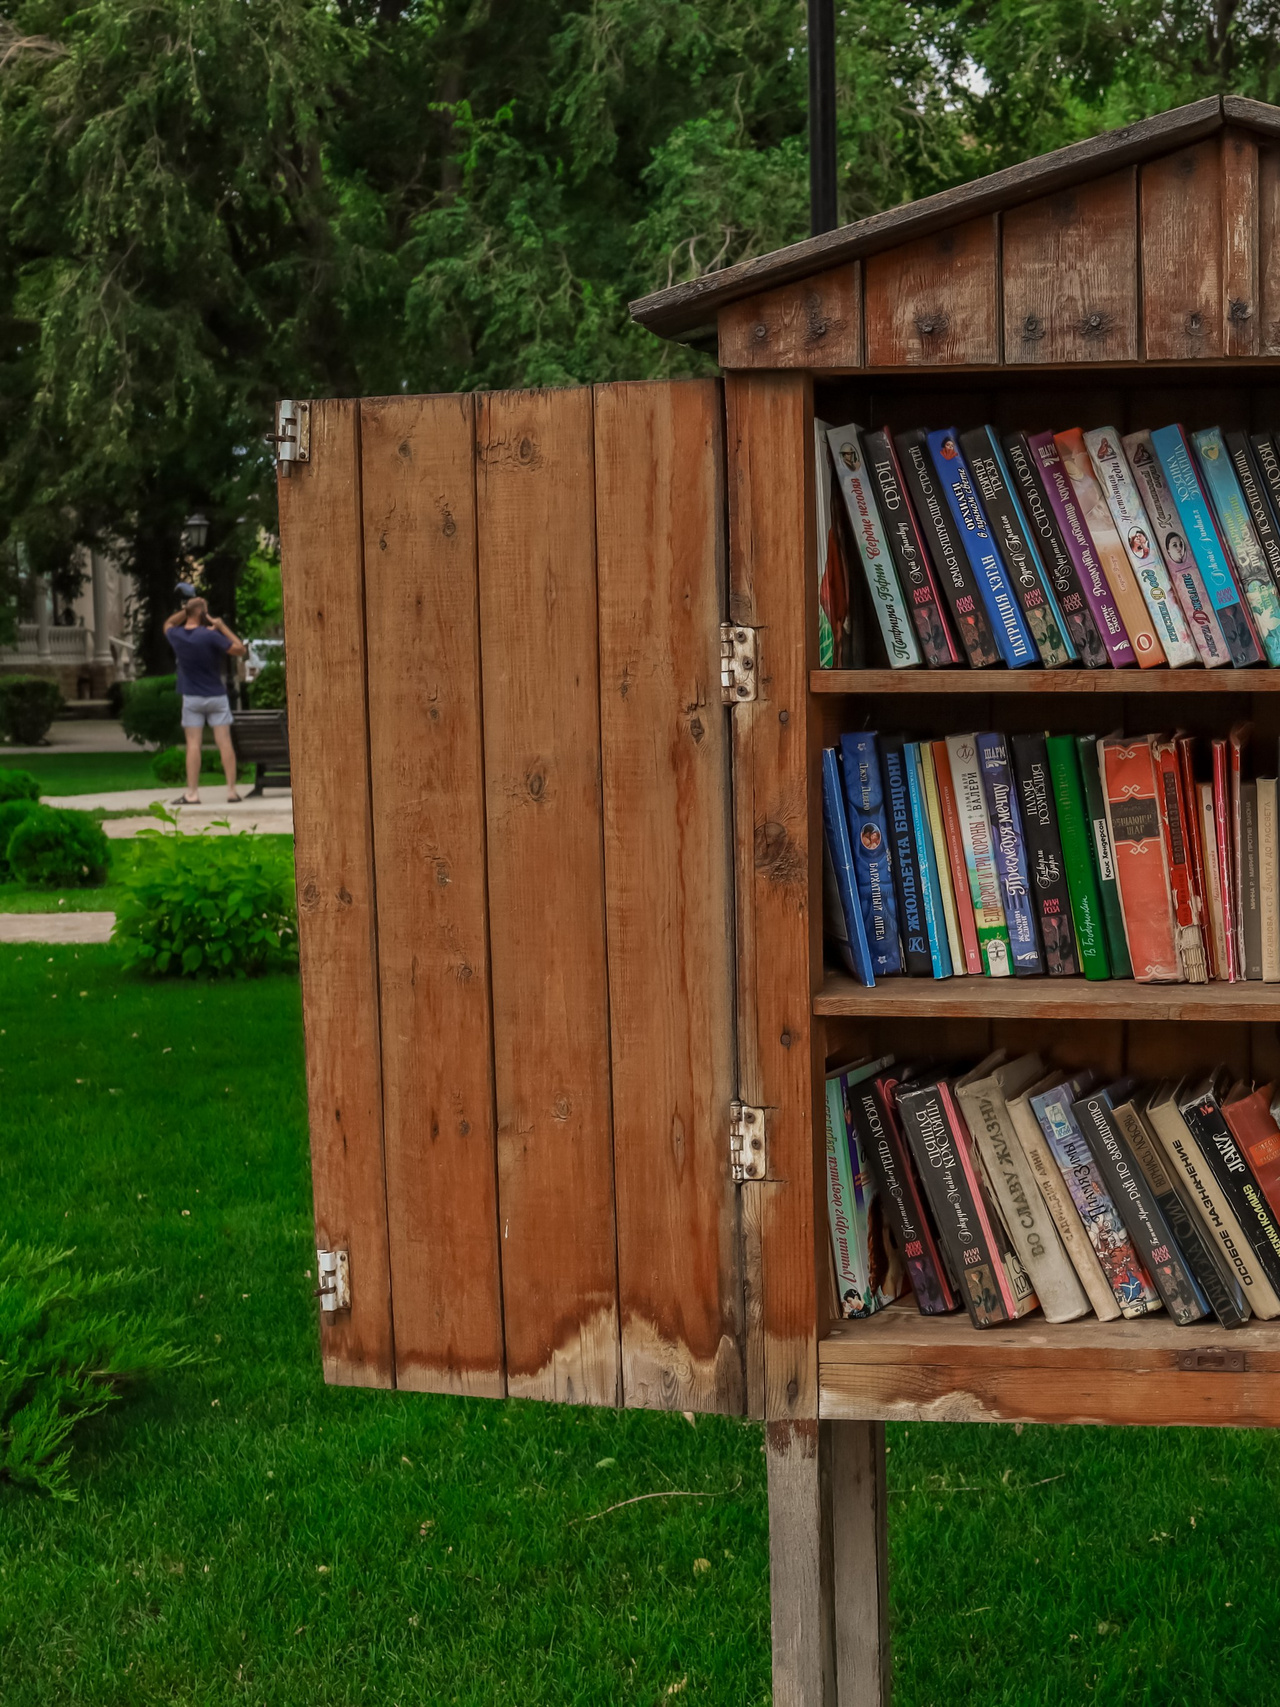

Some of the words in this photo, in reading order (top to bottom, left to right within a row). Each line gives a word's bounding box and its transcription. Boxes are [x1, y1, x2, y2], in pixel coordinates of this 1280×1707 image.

[875, 459, 903, 512] ФЕРН
[909, 445, 935, 496] СТРАСТЕЙ
[956, 467, 974, 496] свете
[985, 457, 1004, 492] ГРЕЗЫ
[1010, 444, 1036, 489] ЛЮБВИ
[1052, 471, 1073, 503] короля
[850, 477, 870, 518] негодяя
[952, 482, 976, 531] ОРХИДЕИ
[1027, 487, 1054, 539] ОСТРОВ
[1234, 449, 1272, 535] ИСКУСИТЕЛЬНИЦА
[858, 517, 882, 560] Сердце
[869, 562, 895, 604] Гэфни
[946, 555, 966, 589] ЗЕМЛЯ
[982, 554, 1005, 592] ХЭГАН
[881, 602, 911, 662] Патриция
[995, 593, 1029, 658] ПАТРИЦИЯ
[1101, 604, 1117, 634] БЕРТРИС
[1108, 606, 1122, 633] СМОЛЛ
[887, 752, 910, 832] БЕНЦОНИ
[969, 771, 983, 810] ВАЛЕРИ
[995, 781, 1014, 825] мечту
[970, 821, 990, 856] КОРОНЫ
[1098, 820, 1110, 859] Хендерсон
[977, 856, 993, 872] ТРИ
[999, 825, 1026, 897] Преследуя
[868, 862, 883, 910] БАРХАТНЫЙ
[897, 836, 921, 931] ЖЮЛЬЕТТА
[980, 880, 1002, 924] ЕДИНОРОГ
[874, 915, 885, 940] АНГЕЛ
[861, 1094, 885, 1140] ЛЮБВИ
[977, 1092, 1014, 1169] ЖИЗНИ
[1087, 1099, 1125, 1162] ЗАВЕЩАНИЮ
[877, 1139, 896, 1172] ТЕНЬ
[1116, 1161, 1132, 1180] ПО
[1213, 1130, 1248, 1177] ЛАКИ
[826, 1155, 845, 1207] девушки
[1004, 1168, 1037, 1234] СЛАВУ
[1123, 1178, 1142, 1201] РАЙ
[1173, 1138, 1224, 1228] НАЗНАЧЕНИЕ
[835, 1208, 850, 1234] друг
[1243, 1183, 1273, 1227] КОЛЛИНЗ
[1026, 1232, 1046, 1258] ВО
[1220, 1228, 1255, 1288] ОСОБОЕ
